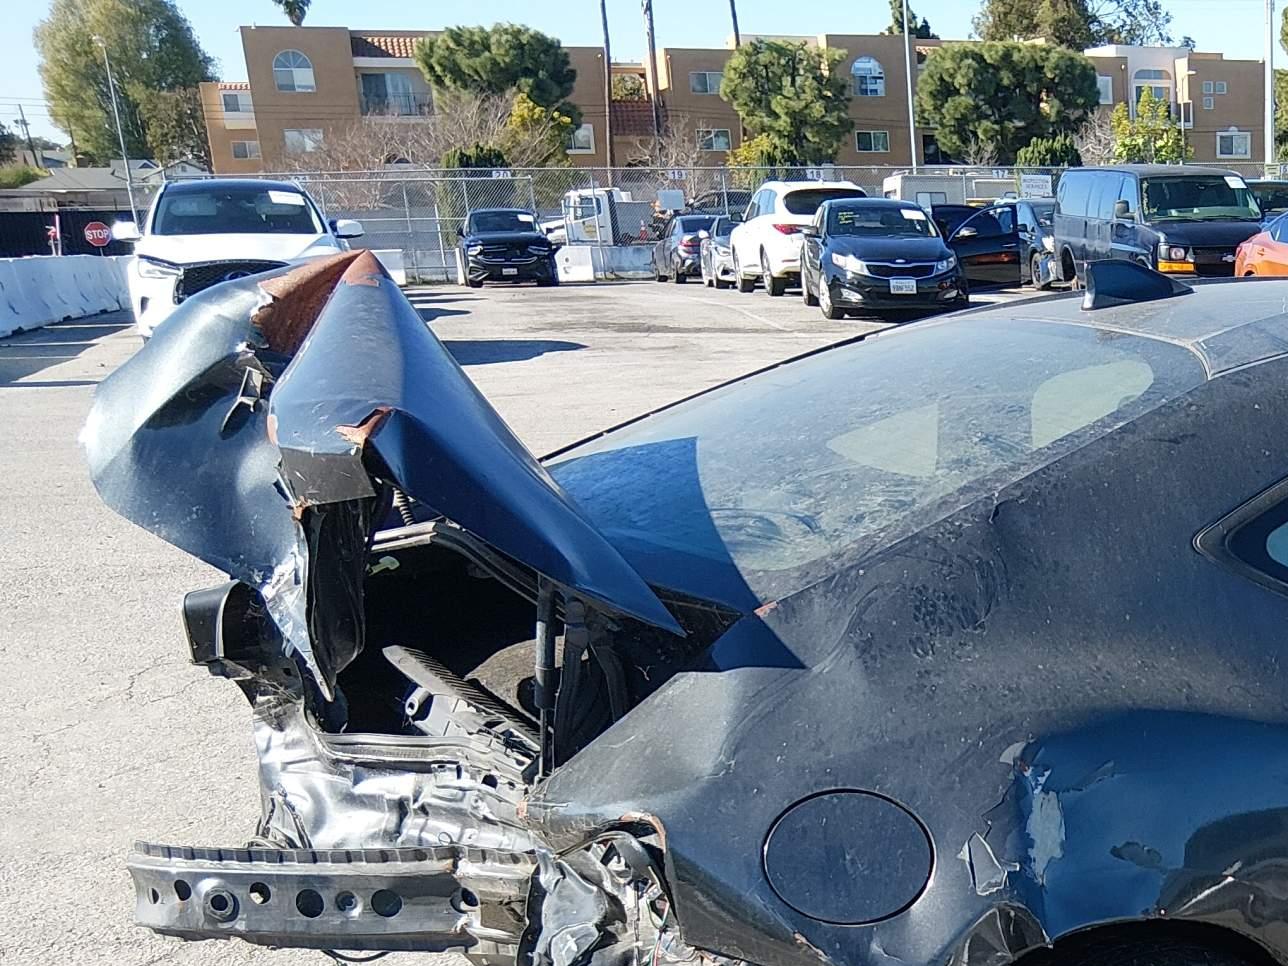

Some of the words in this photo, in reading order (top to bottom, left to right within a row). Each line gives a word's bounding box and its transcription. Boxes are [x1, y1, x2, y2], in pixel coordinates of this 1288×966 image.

[671, 170, 683, 179] 19
[810, 170, 821, 179] 18
[86, 229, 109, 240] STOP
